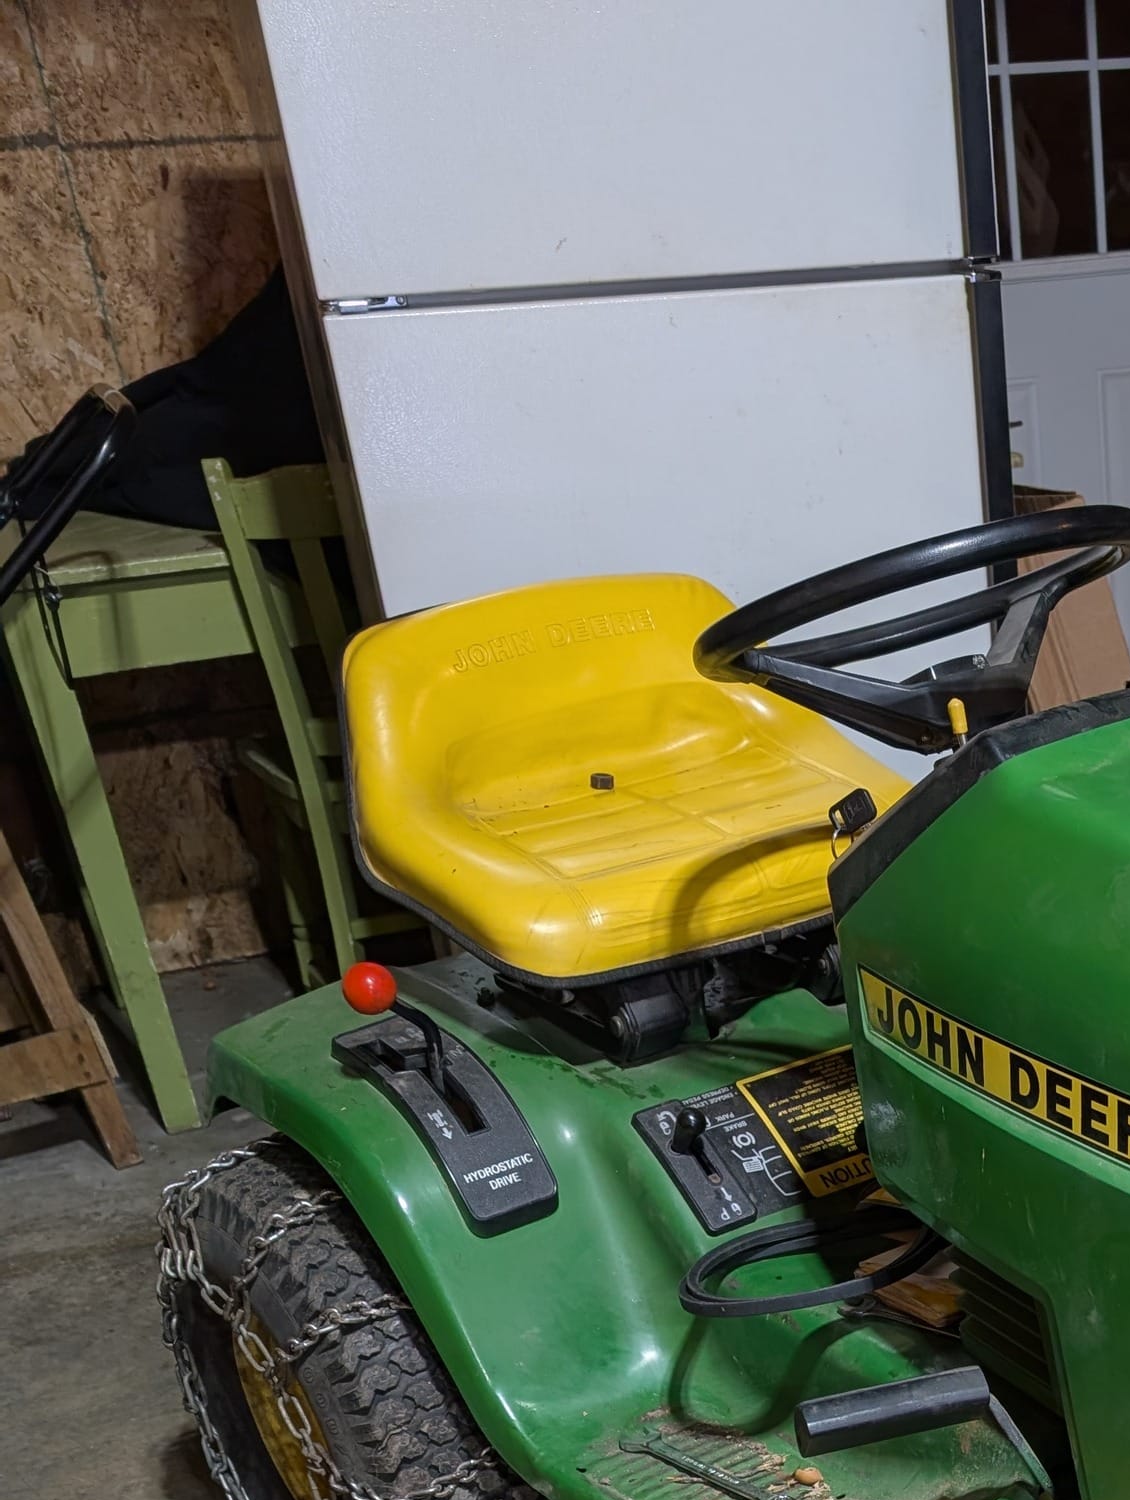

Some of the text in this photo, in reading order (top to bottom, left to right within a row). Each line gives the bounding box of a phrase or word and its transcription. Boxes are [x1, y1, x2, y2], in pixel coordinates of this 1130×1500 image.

[453, 609, 656, 673] JOHN DEERE
[877, 987, 985, 1088] JOHN
[715, 1111, 735, 1122] PARK
[723, 1120, 748, 1132] BRAKE
[463, 1153, 534, 1183] HYDROSTATIC
[488, 1172, 522, 1191] DRIVE
[820, 1158, 873, 1188] UTION
